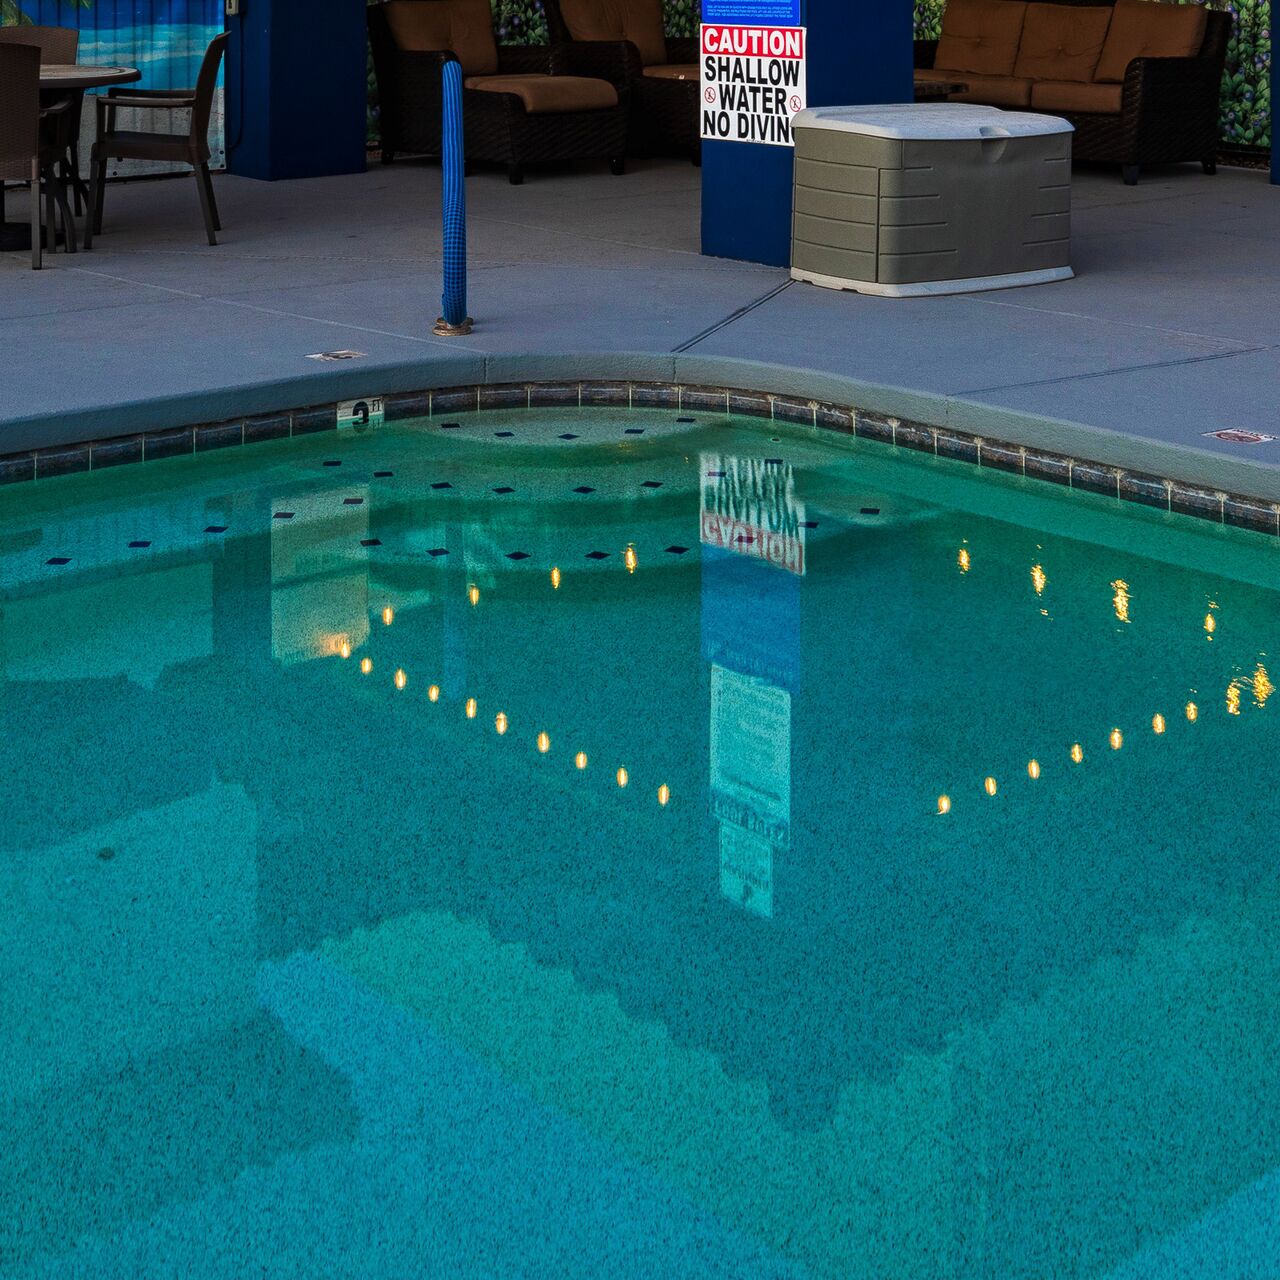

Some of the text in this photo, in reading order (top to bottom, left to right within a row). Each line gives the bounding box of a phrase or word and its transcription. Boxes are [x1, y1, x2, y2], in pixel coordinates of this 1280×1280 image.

[704, 28, 800, 56] CAUTION
[704, 56, 800, 87] SHALLOW
[718, 83, 788, 115] WATER
[703, 110, 795, 143] NO DIVIN
[373, 399, 380, 412] FT
